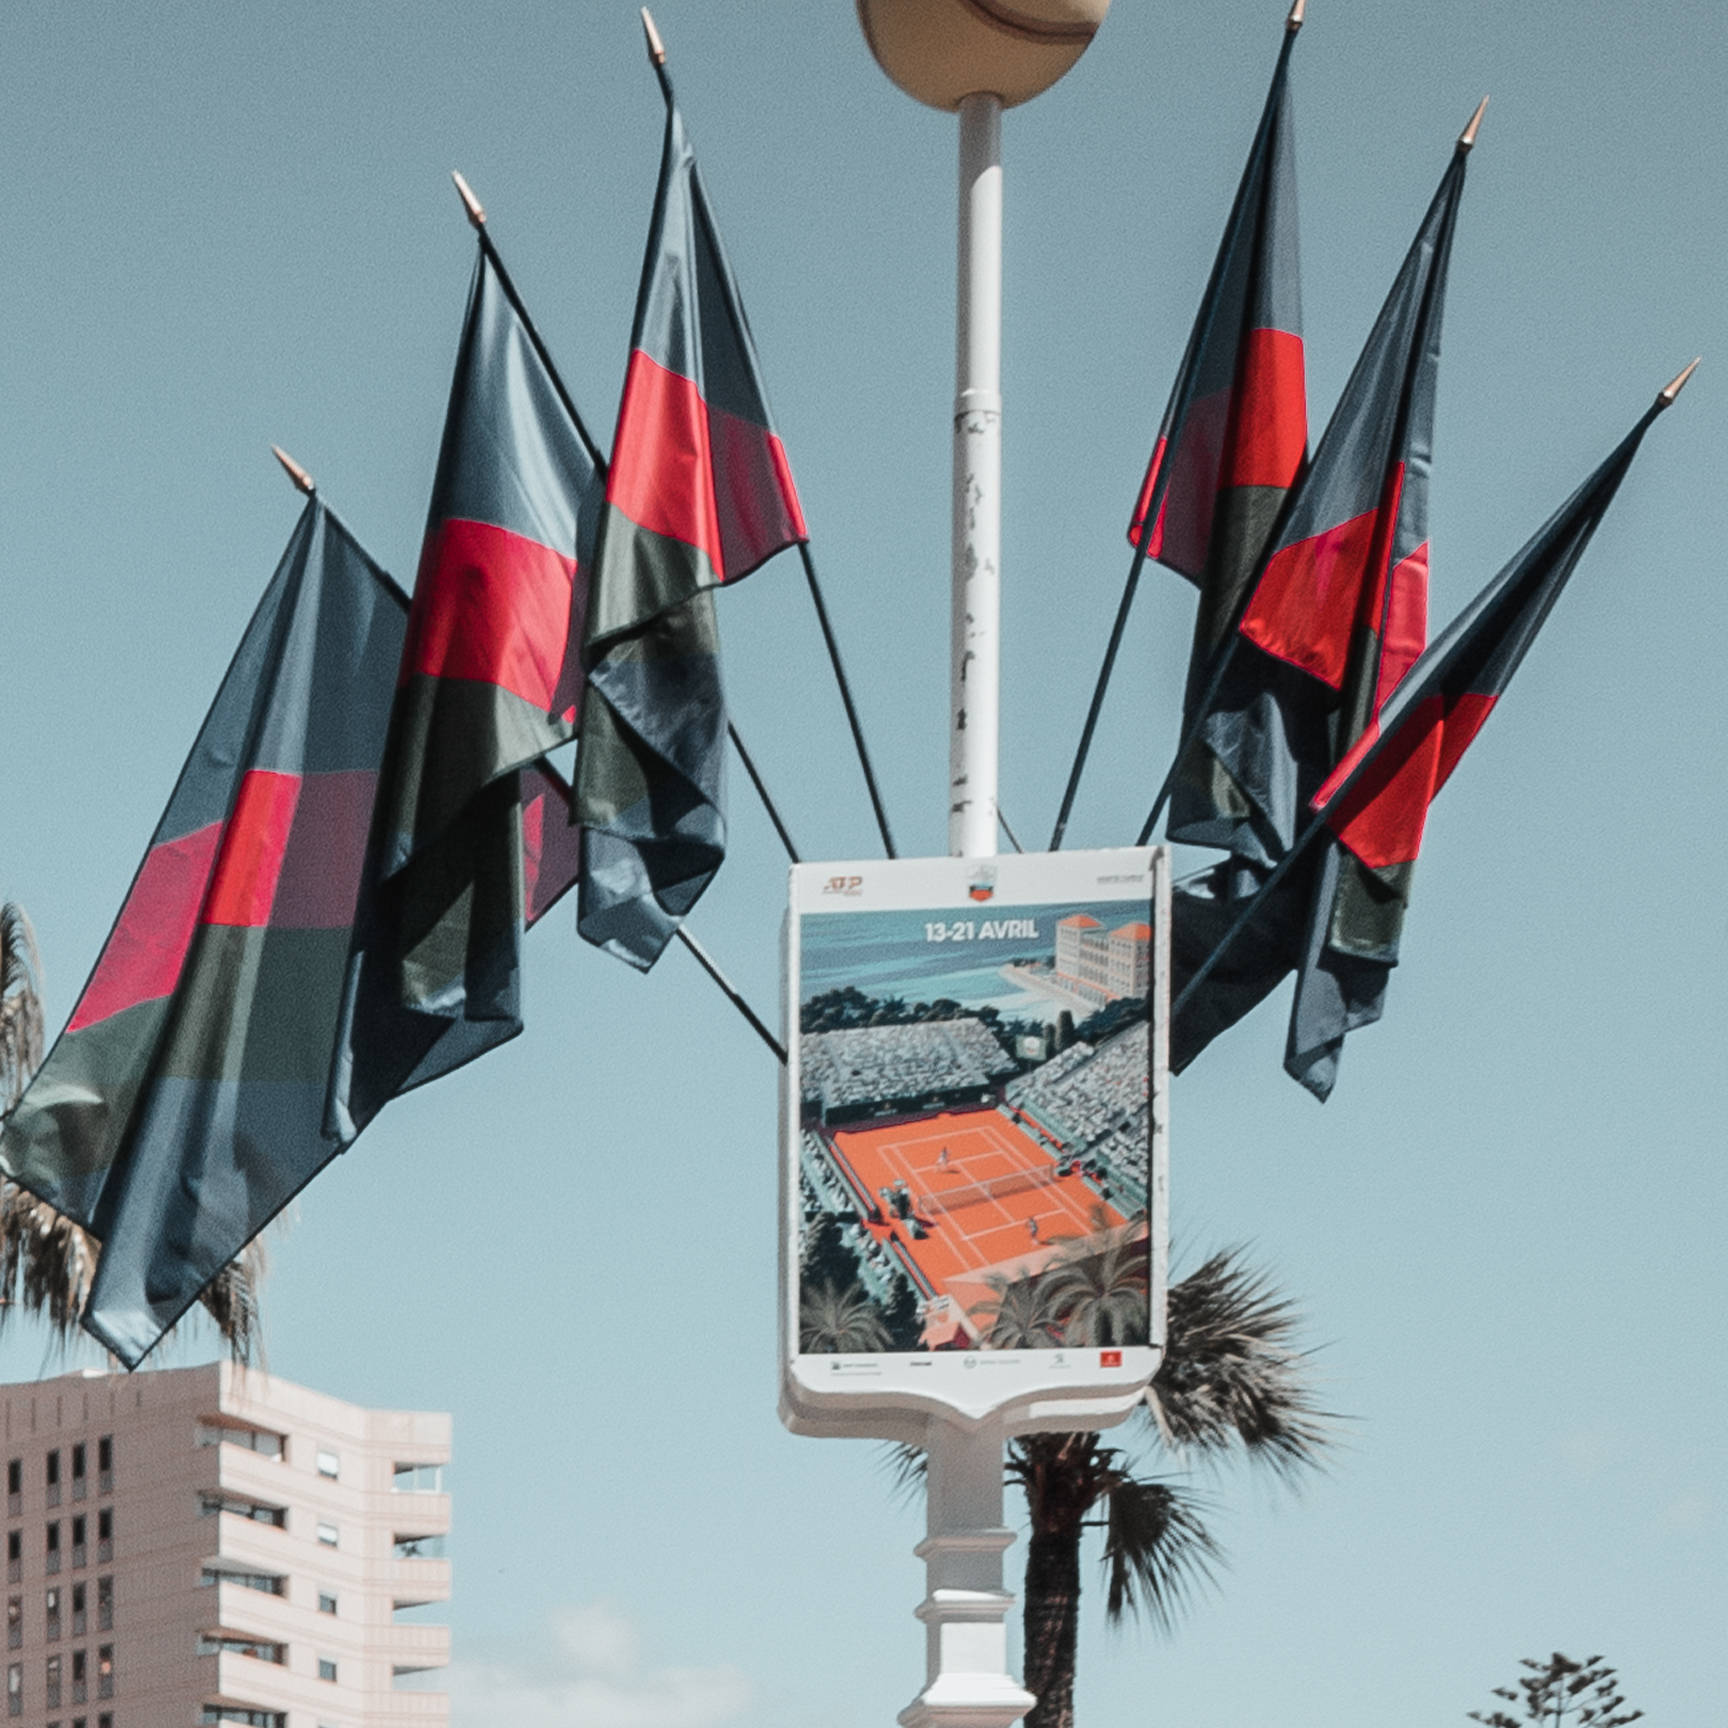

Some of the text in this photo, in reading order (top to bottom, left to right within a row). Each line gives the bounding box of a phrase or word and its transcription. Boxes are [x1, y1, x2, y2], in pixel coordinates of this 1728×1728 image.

[823, 876, 862, 889] ATP
[925, 919, 1039, 942] 13-21 AVRIL
